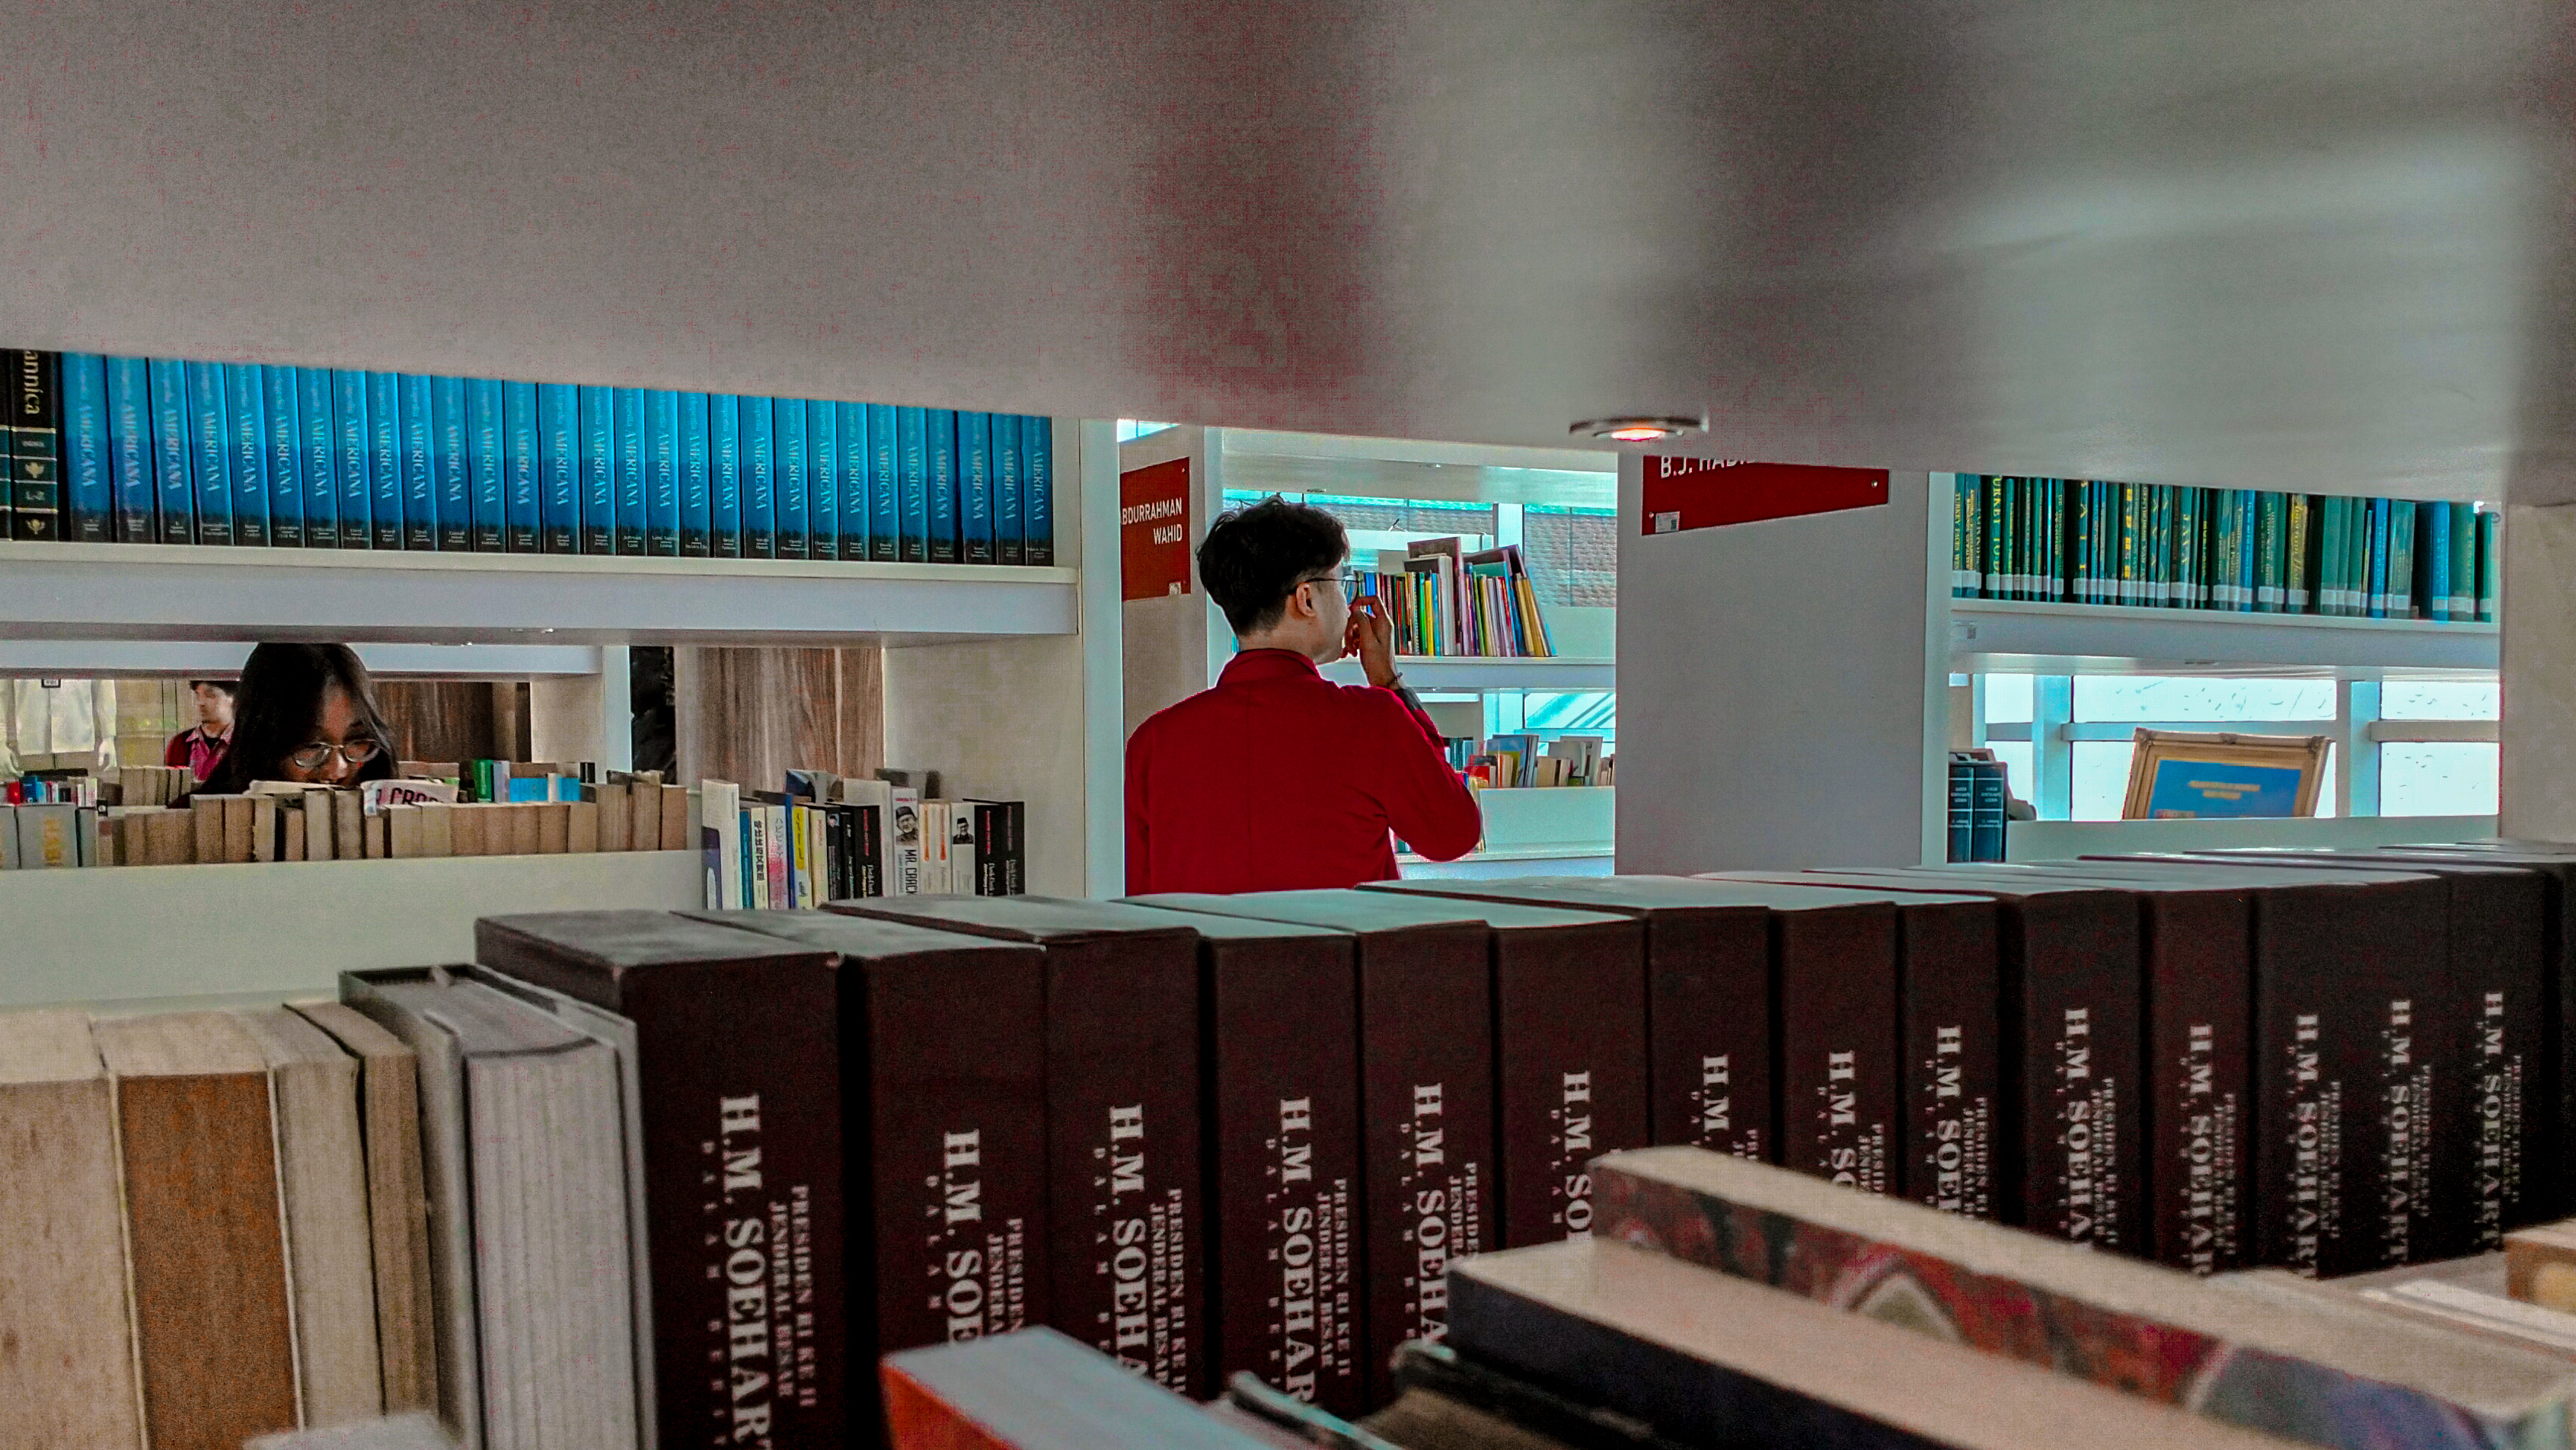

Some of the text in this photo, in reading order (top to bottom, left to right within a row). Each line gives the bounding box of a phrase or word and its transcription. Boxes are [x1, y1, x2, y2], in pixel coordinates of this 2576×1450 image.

[79, 405, 97, 487] AMERICANA
[121, 404, 141, 488] AMERICANA
[163, 409, 182, 490] AMERICANA
[203, 411, 220, 492] AMERICANA
[239, 411, 257, 493] AMERICANA
[275, 413, 292, 495] AMERICANA
[311, 417, 328, 497] AMERICANA
[346, 418, 362, 498] AMERICANA
[378, 421, 394, 500] AMERICANA
[410, 421, 426, 500] AMERICANA
[447, 425, 462, 502] AMERICANA
[482, 424, 496, 503] AMERICANA
[516, 428, 531, 504] AMERICANA
[555, 429, 569, 506] AMERICANA
[593, 430, 607, 506] AMERICANA
[624, 432, 639, 506] AMERICANA
[658, 432, 671, 508] AMERICANA
[689, 433, 702, 509] AMERICANA
[720, 436, 734, 510] AMERICANA
[754, 436, 768, 510] AMERICANA
[788, 438, 801, 512] AMERICANA
[819, 441, 832, 513] AMERICANA
[848, 442, 860, 515] AMERICANA
[878, 442, 891, 516] AMERICANA
[908, 446, 920, 516] AMERICANA
[935, 448, 948, 519] AMERICANA
[972, 447, 985, 520] AMERICANA
[1003, 448, 1016, 520] AMERICANA
[1033, 449, 1045, 521] AMERICANA
[1121, 497, 1182, 525] BDURRAHMAN
[1154, 524, 1182, 545] WAHID
[1938, 1025, 1962, 1108] H.M.
[2067, 1008, 2091, 1090] H.M.
[2190, 1024, 2214, 1104] H.M.
[2298, 1014, 2319, 1091] H.M.
[2391, 998, 2412, 1074] H.M.
[2485, 991, 2504, 1064] H.M.
[1565, 1071, 1593, 1162] H.M.
[1704, 1054, 1731, 1142] H.M.
[1830, 1049, 1856, 1135] H.M.
[722, 1093, 765, 1205] H.M.
[1111, 1103, 1148, 1206] H.M.
[1402, 1123, 1414, 1241] DALAM
[946, 1129, 986, 1343] H.M. SOE
[1095, 1148, 1111, 1274] DALAM
[1267, 1139, 1280, 1261] DALAM
[1336, 1178, 1350, 1284] PRESIDEN
[1416, 1082, 1450, 1344] H.M. SOEHA
[771, 1201, 792, 1319] JENDERAL
[793, 1185, 813, 1304] PRESIDEN
[1151, 1203, 1168, 1312] JENDERAL
[1170, 1188, 1186, 1298] PRESIDEN
[1282, 1096, 1317, 1402] H.M. SOEHAR
[1318, 1192, 1335, 1368] JENDERAL BESAR
[800, 1347, 816, 1379] KE
[1173, 1337, 1188, 1367] KE
[1339, 1322, 1351, 1352] KE
[1339, 1359, 1352, 1376] II
[800, 1388, 818, 1407] II
